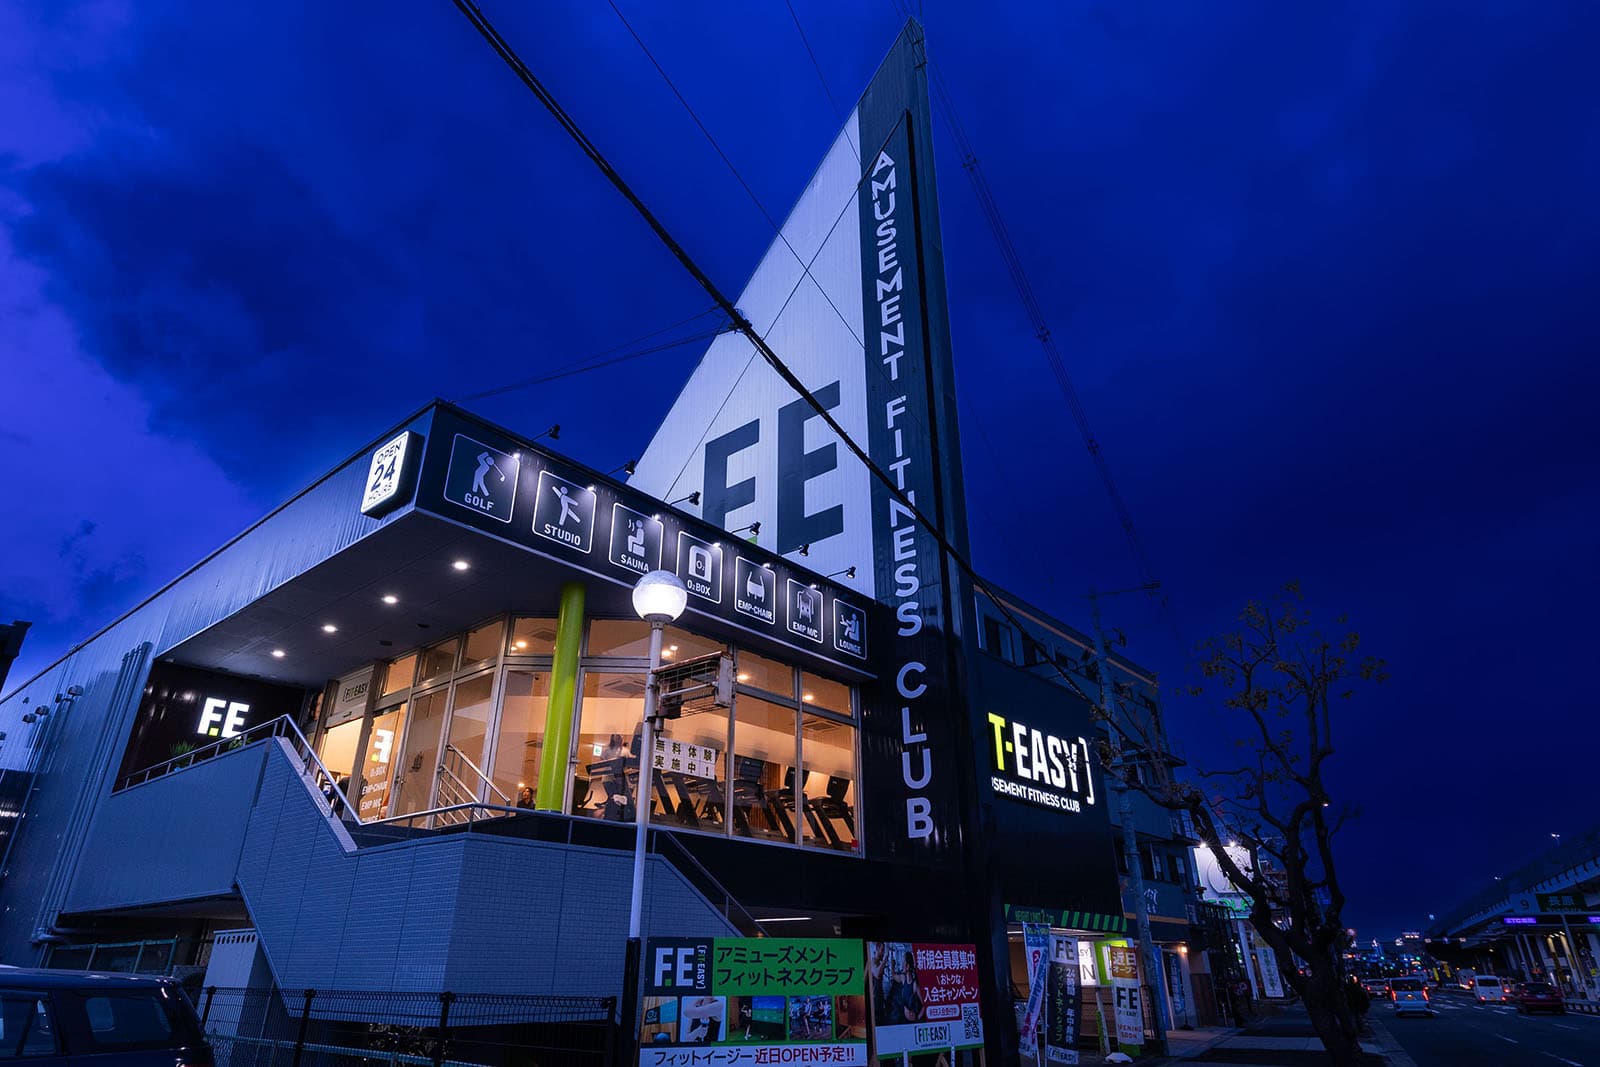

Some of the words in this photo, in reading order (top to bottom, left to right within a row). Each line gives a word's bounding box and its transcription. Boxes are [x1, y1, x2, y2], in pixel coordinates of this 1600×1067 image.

[871, 150, 905, 382] AMUSEMENT
[376, 441, 402, 465] OPEN
[370, 455, 397, 493] 24
[464, 493, 495, 512] GOLF
[886, 395, 922, 638] FITNESS
[543, 523, 582, 547] STUDIO
[620, 553, 650, 573] SAUNA
[737, 599, 773, 621] EMP-CHAIR
[792, 621, 808, 634] EMP
[839, 639, 862, 656] LOUNGE
[896, 661, 935, 840] CLUB
[991, 776, 1028, 800] SEMENT
[1027, 788, 1061, 809] FITNESS
[1060, 797, 1081, 813] CLUB
[717, 946, 838, 966] アミューズメント
[916, 949, 977, 971] 新規会員募集中
[717, 967, 856, 988] フィットネスクラブ
[924, 986, 979, 1003] 入会キャンペーン
